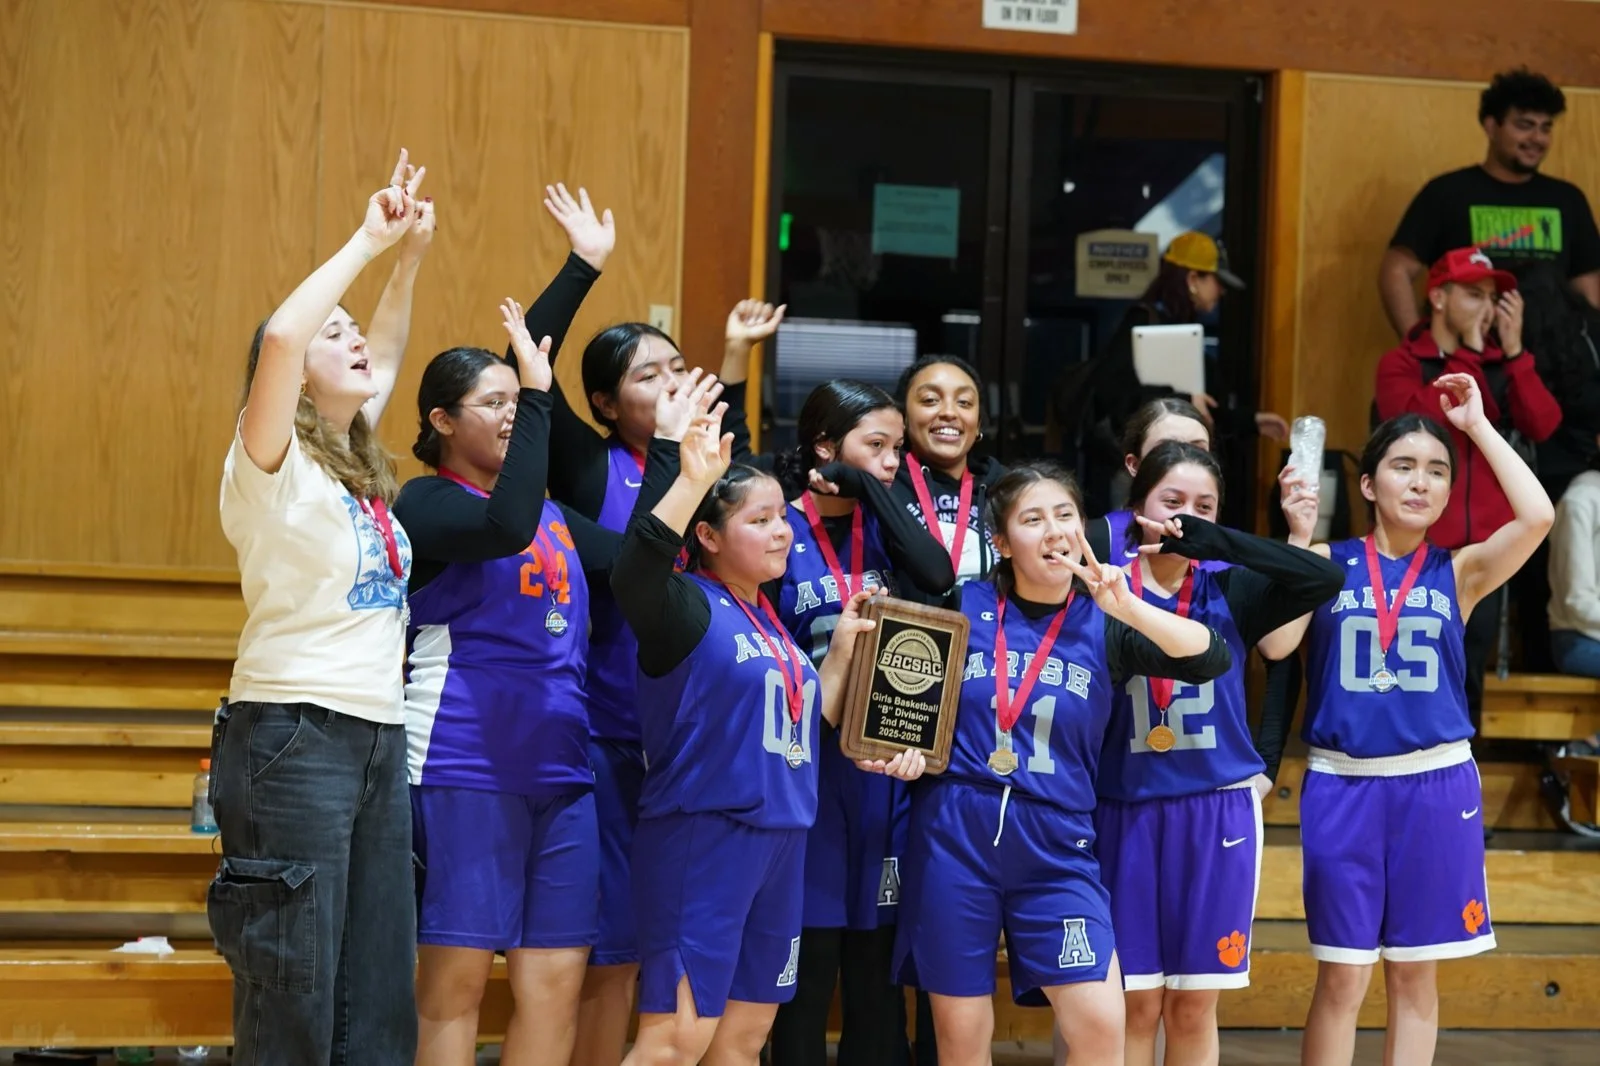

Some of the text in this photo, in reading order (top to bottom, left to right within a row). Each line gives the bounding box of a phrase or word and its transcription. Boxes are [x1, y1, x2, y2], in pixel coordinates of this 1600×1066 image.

[880, 652, 942, 677] BACSAC
[1340, 615, 1443, 692] 05
[762, 667, 817, 763] 01
[872, 692, 939, 714] Girls Basketball
[881, 716, 923, 733] 2nd Place
[895, 707, 930, 723] Division
[1125, 674, 1217, 754] 12
[879, 727, 921, 743] 2025-2026
[990, 688, 1057, 775] 11
[876, 857, 900, 907] A
[776, 935, 801, 987] A
[1058, 918, 1096, 968] A
